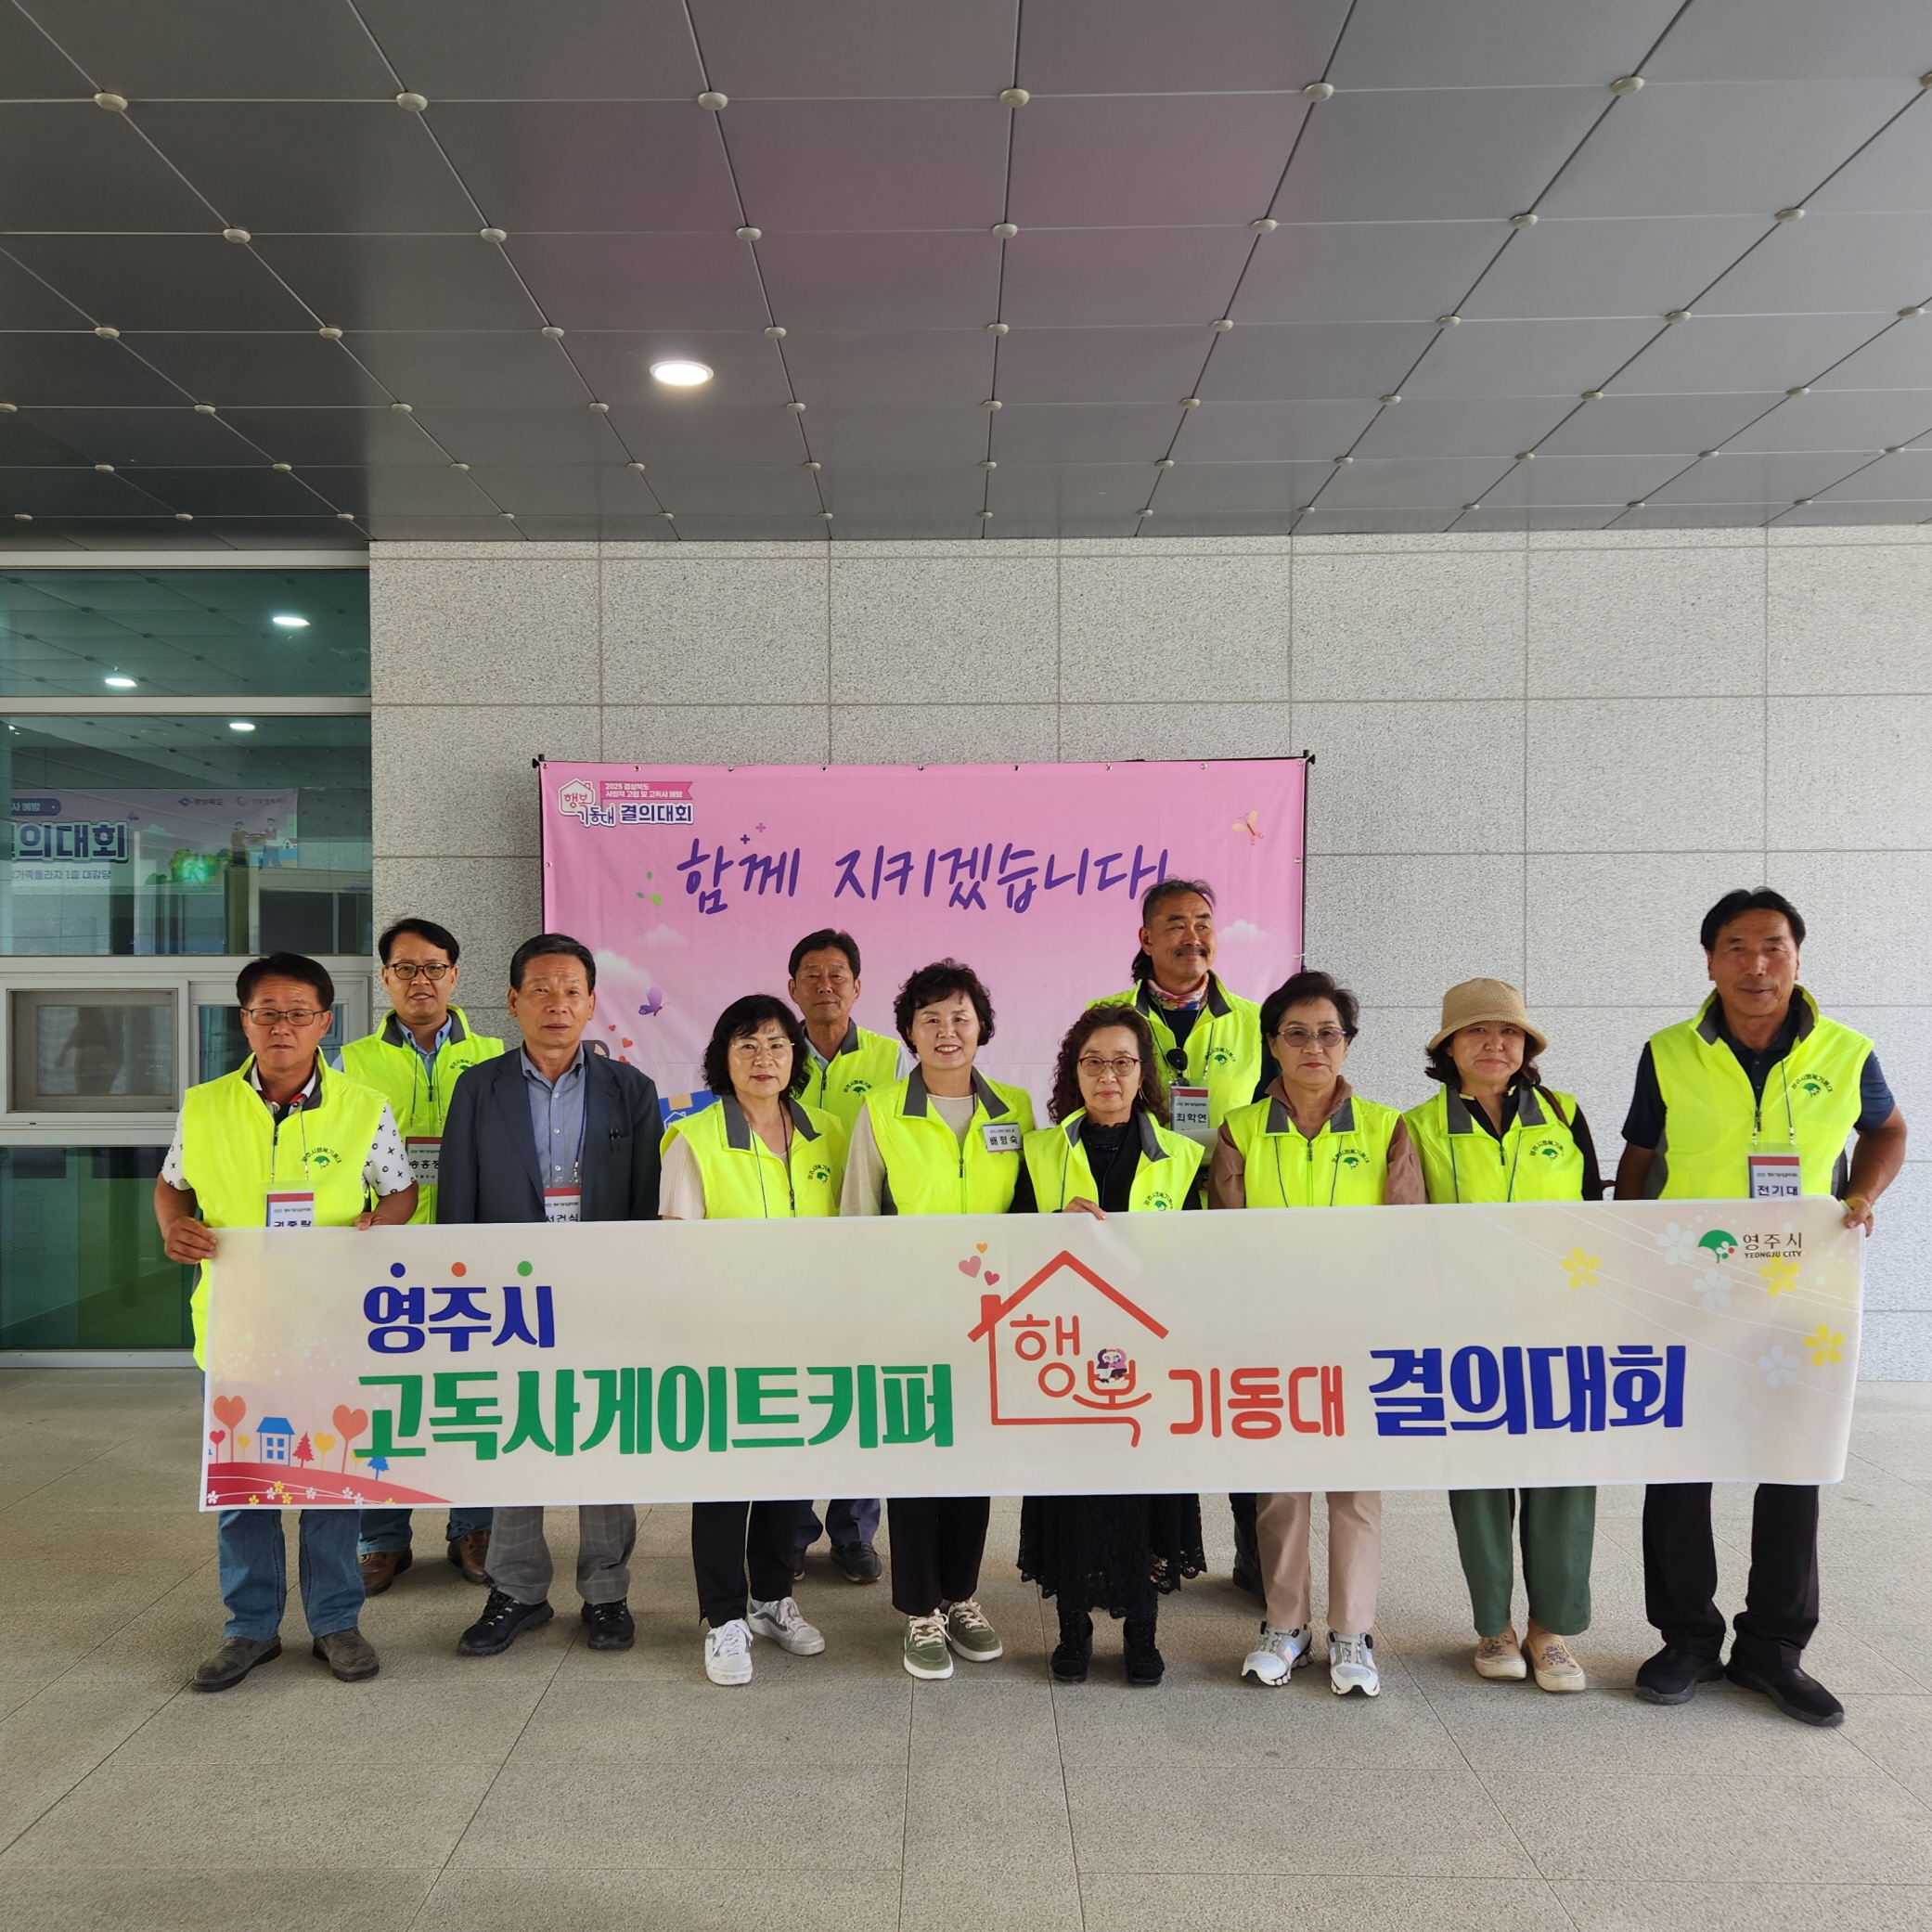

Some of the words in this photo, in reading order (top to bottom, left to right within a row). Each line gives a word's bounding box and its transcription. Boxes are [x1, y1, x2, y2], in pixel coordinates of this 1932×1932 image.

[563, 792, 588, 808] 행복
[579, 804, 614, 825] 기동대
[621, 805, 692, 821] 결의대회
[11, 824, 125, 858] 의대회
[677, 838, 800, 914] 함께
[1177, 1113, 1207, 1123] 최학연
[1757, 1185, 1799, 1197] 전기대
[1743, 1232, 1802, 1251] 영주시
[364, 1286, 555, 1354] 영주시
[355, 1363, 954, 1460] 고독사게이트키퍼
[1169, 1365, 1345, 1439] 기동대
[1369, 1345, 1687, 1436] 결의대회
